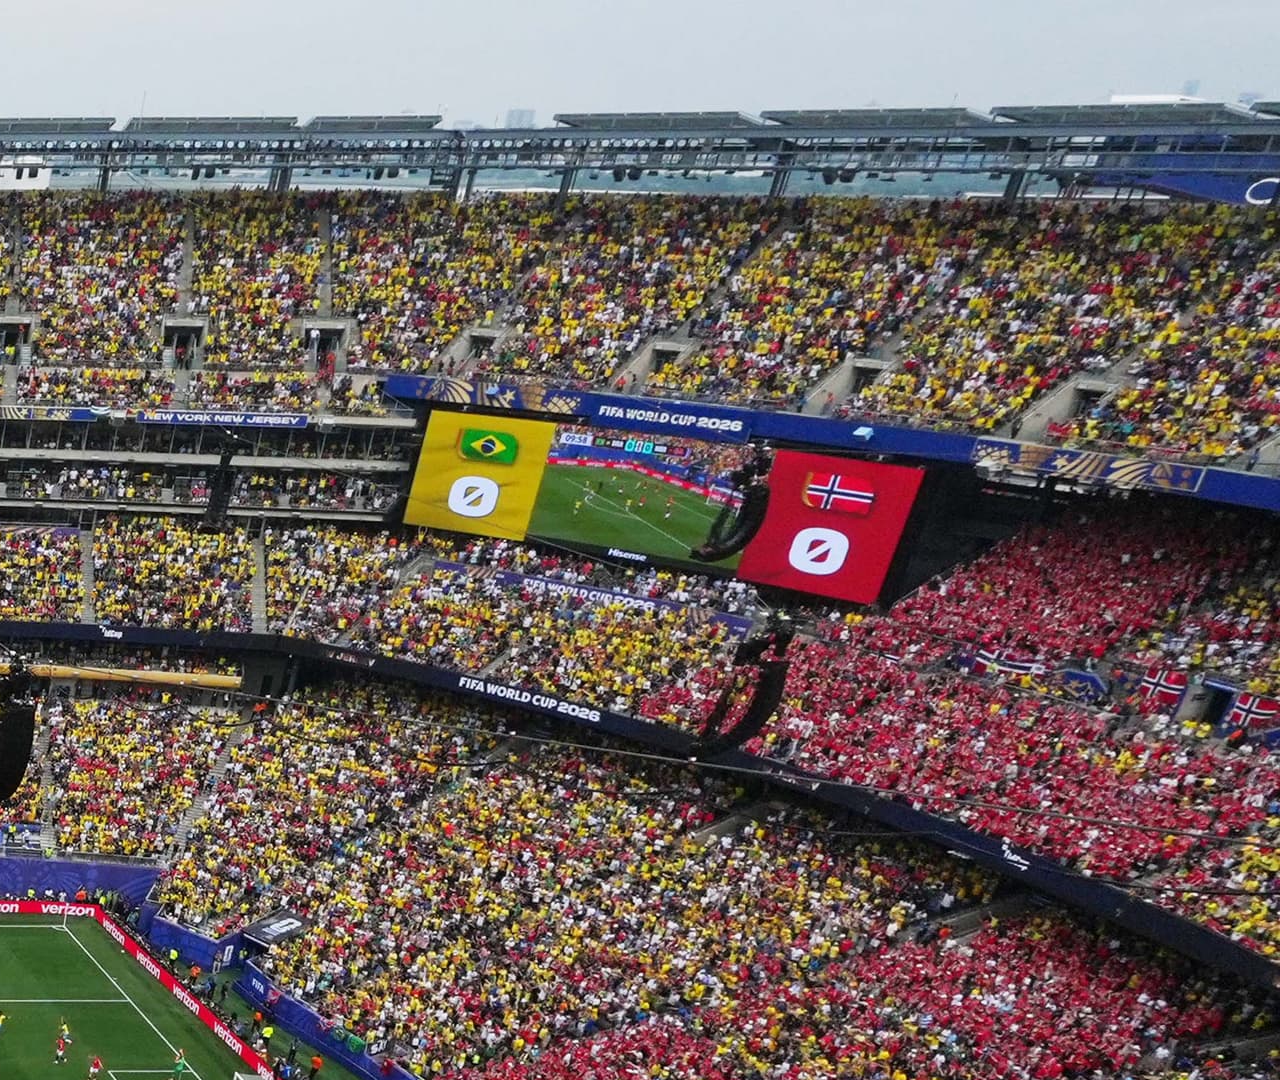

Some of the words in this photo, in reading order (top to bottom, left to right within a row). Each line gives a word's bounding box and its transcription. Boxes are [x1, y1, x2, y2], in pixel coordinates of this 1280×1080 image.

[144, 412, 175, 422] NEW
[177, 413, 211, 423] YORK
[214, 414, 244, 424] NEW
[246, 416, 300, 426] JERSEY
[598, 405, 624, 418] FIFA
[625, 409, 669, 423] WORLD
[670, 414, 696, 426] CUP
[696, 417, 743, 432] 2026
[608, 548, 648, 562] Hisense
[458, 676, 486, 693] FIFA
[486, 683, 531, 703] WORLD
[532, 694, 558, 710] CUP
[557, 701, 601, 723] 2026
[41, 902, 95, 918] verizon
[103, 918, 125, 946] verizon
[136, 949, 161, 980] verizon
[172, 983, 200, 1016] verizon
[252, 978, 265, 995] FIFA
[213, 1021, 243, 1056] verizon
